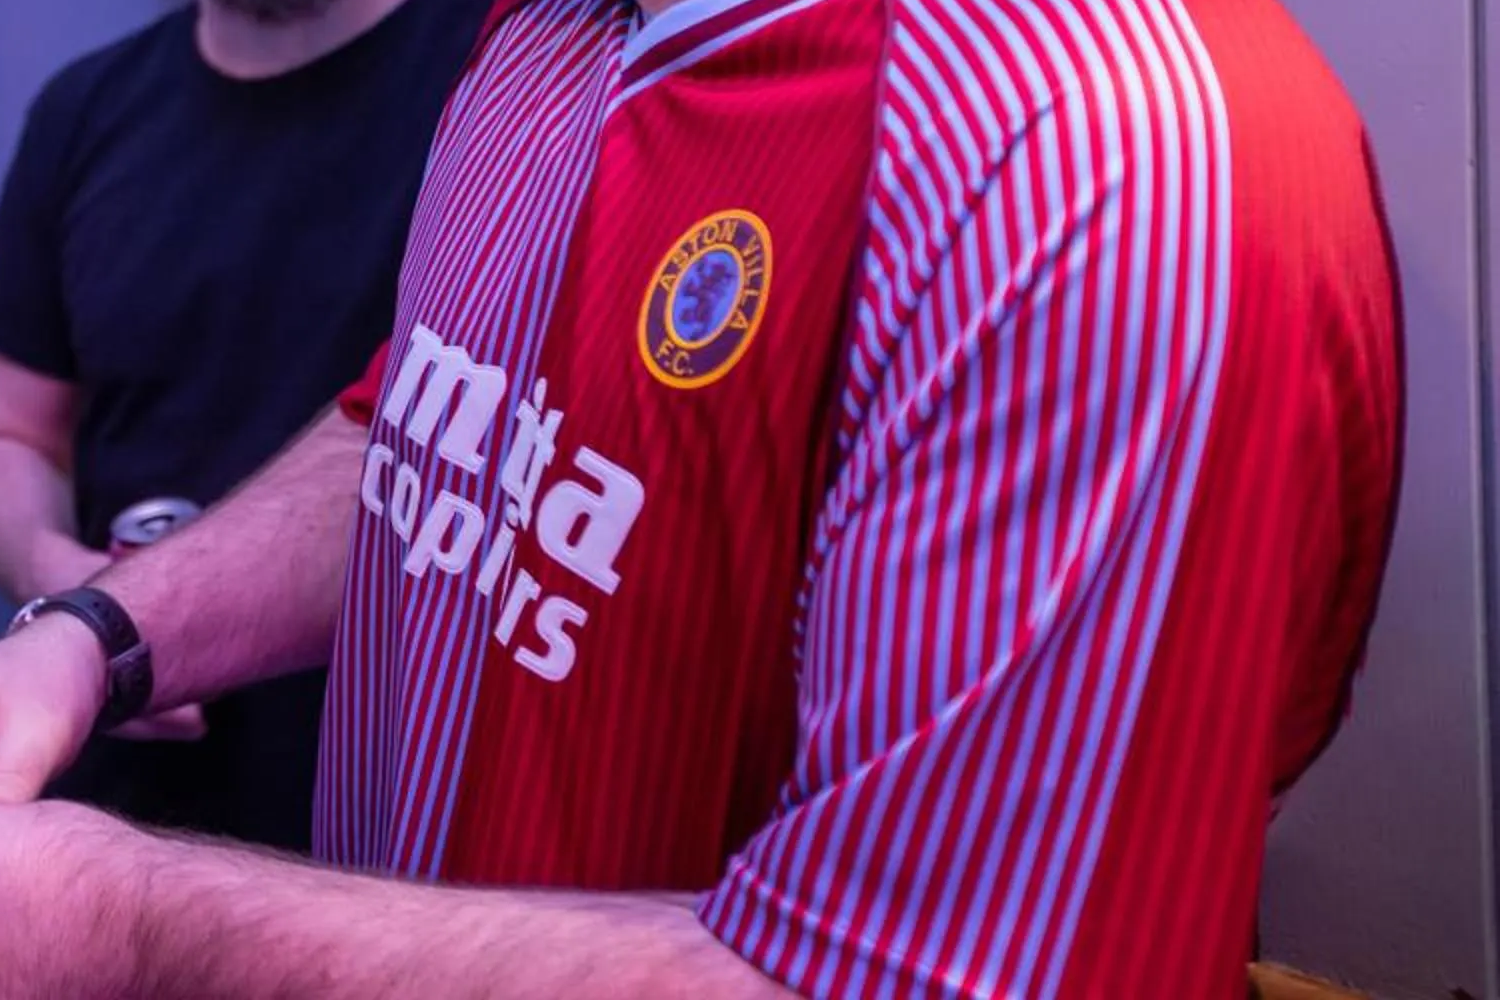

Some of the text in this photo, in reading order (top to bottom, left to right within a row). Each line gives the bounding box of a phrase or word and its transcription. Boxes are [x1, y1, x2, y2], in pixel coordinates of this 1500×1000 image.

[660, 219, 764, 329] ASTON VILLA
[361, 443, 588, 682] copirs
